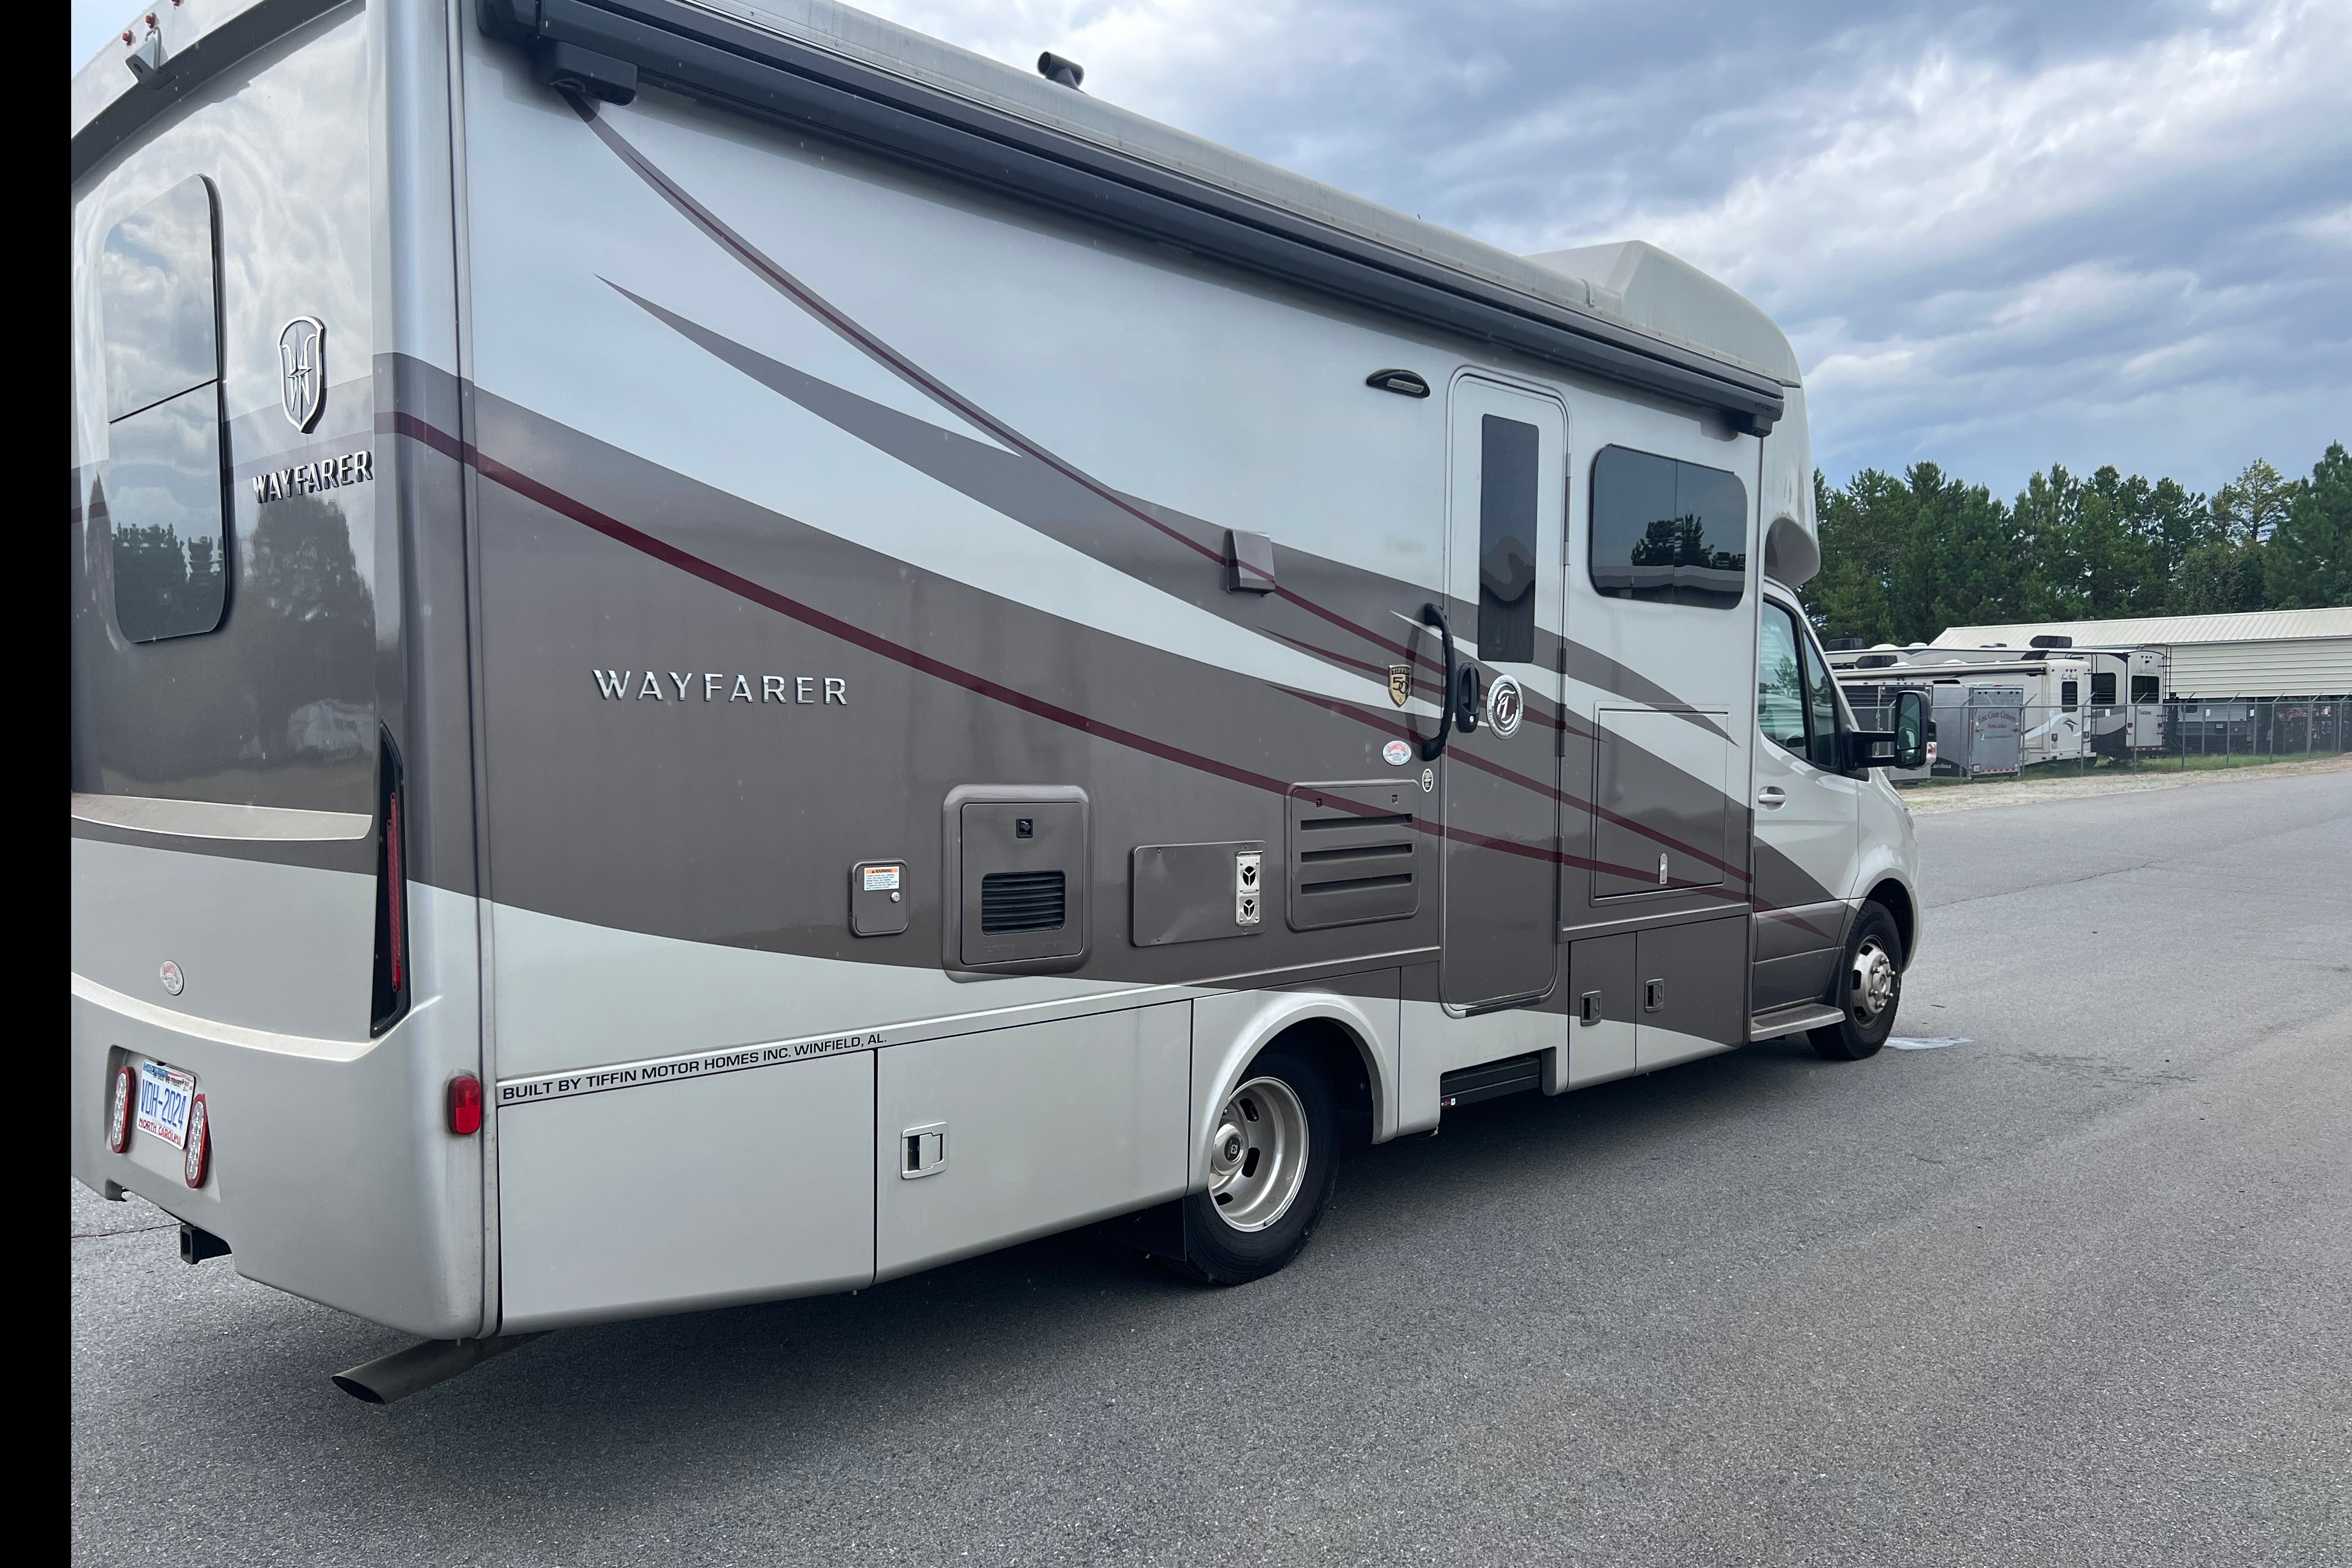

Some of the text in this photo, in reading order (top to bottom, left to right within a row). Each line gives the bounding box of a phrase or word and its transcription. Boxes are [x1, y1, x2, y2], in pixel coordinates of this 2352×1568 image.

[252, 450, 373, 503] WAYFARER
[592, 669, 848, 705] WAYFARER
[1392, 677, 1409, 694] 50
[503, 1034, 887, 1100] BUILT BY TIFFIN MOTOR HOMES INC. WINFIELD, AL.
[138, 1118, 157, 1134] NORTH
[158, 1125, 182, 1146] CAROLINA
